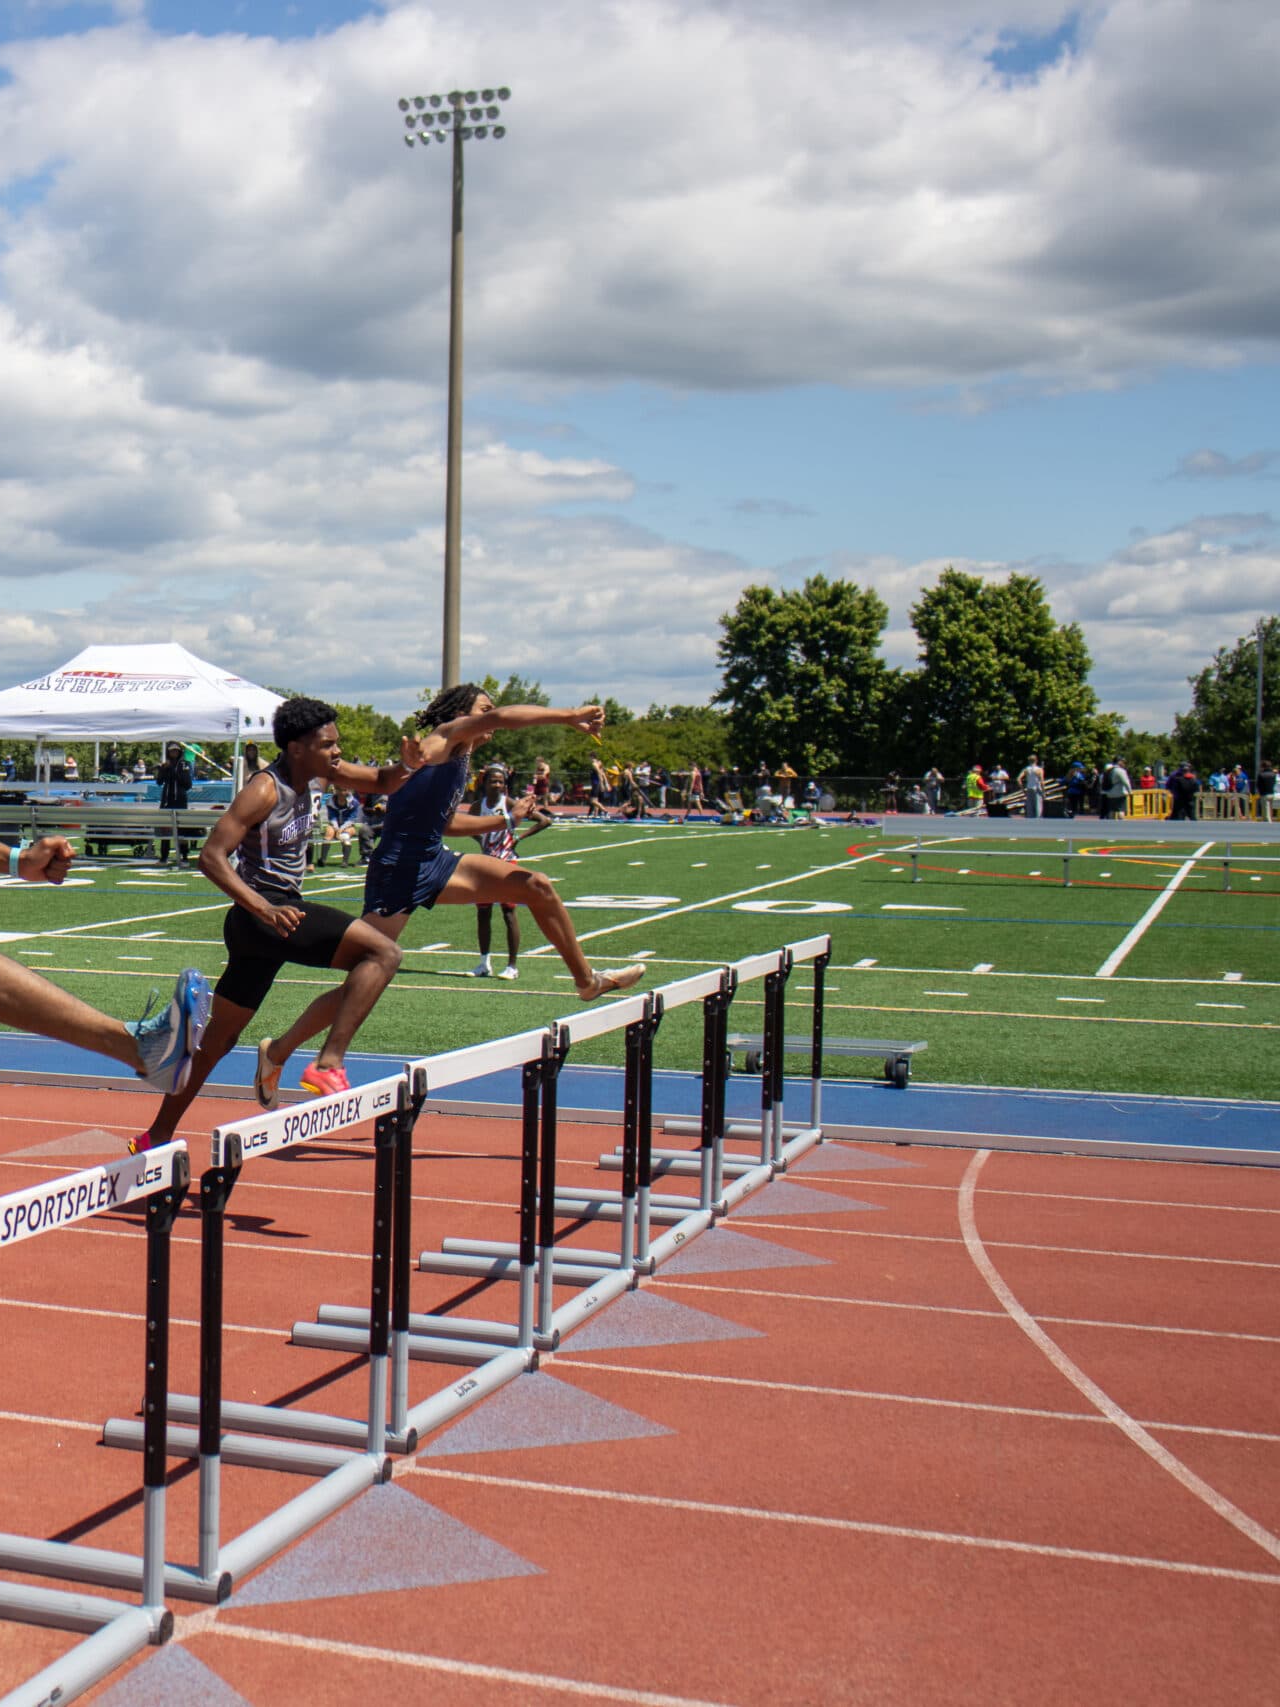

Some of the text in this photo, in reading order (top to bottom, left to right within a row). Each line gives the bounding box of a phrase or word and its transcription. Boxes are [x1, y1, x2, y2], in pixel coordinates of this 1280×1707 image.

[24, 675, 192, 694] ATHLETICS
[243, 1092, 392, 1150] UCS SPORTSPLEX UCS
[0, 1171, 121, 1241] SPORTSPLEX
[135, 1165, 163, 1188] UCS
